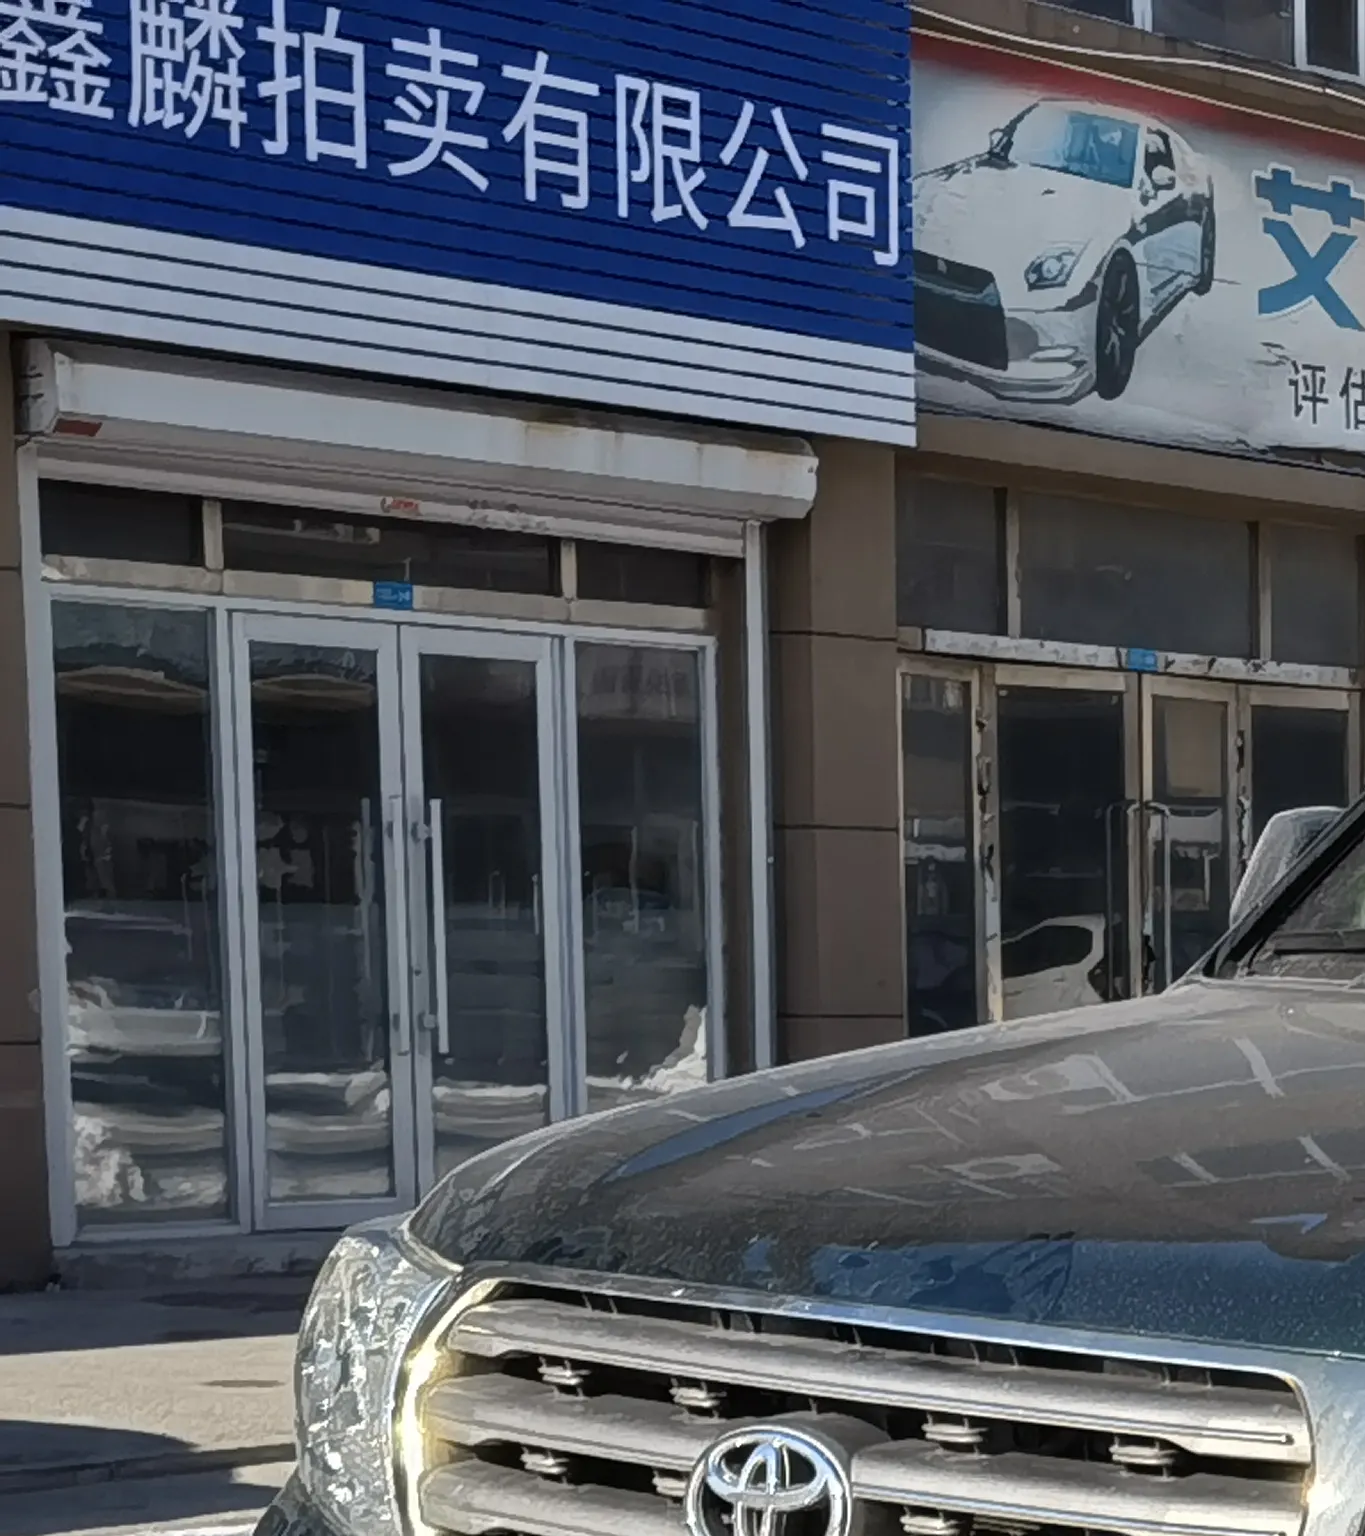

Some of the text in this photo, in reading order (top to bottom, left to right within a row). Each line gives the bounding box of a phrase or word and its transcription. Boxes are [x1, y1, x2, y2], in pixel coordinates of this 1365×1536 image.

[0, 0, 903, 267] 鑫麟拍卖有限公司
